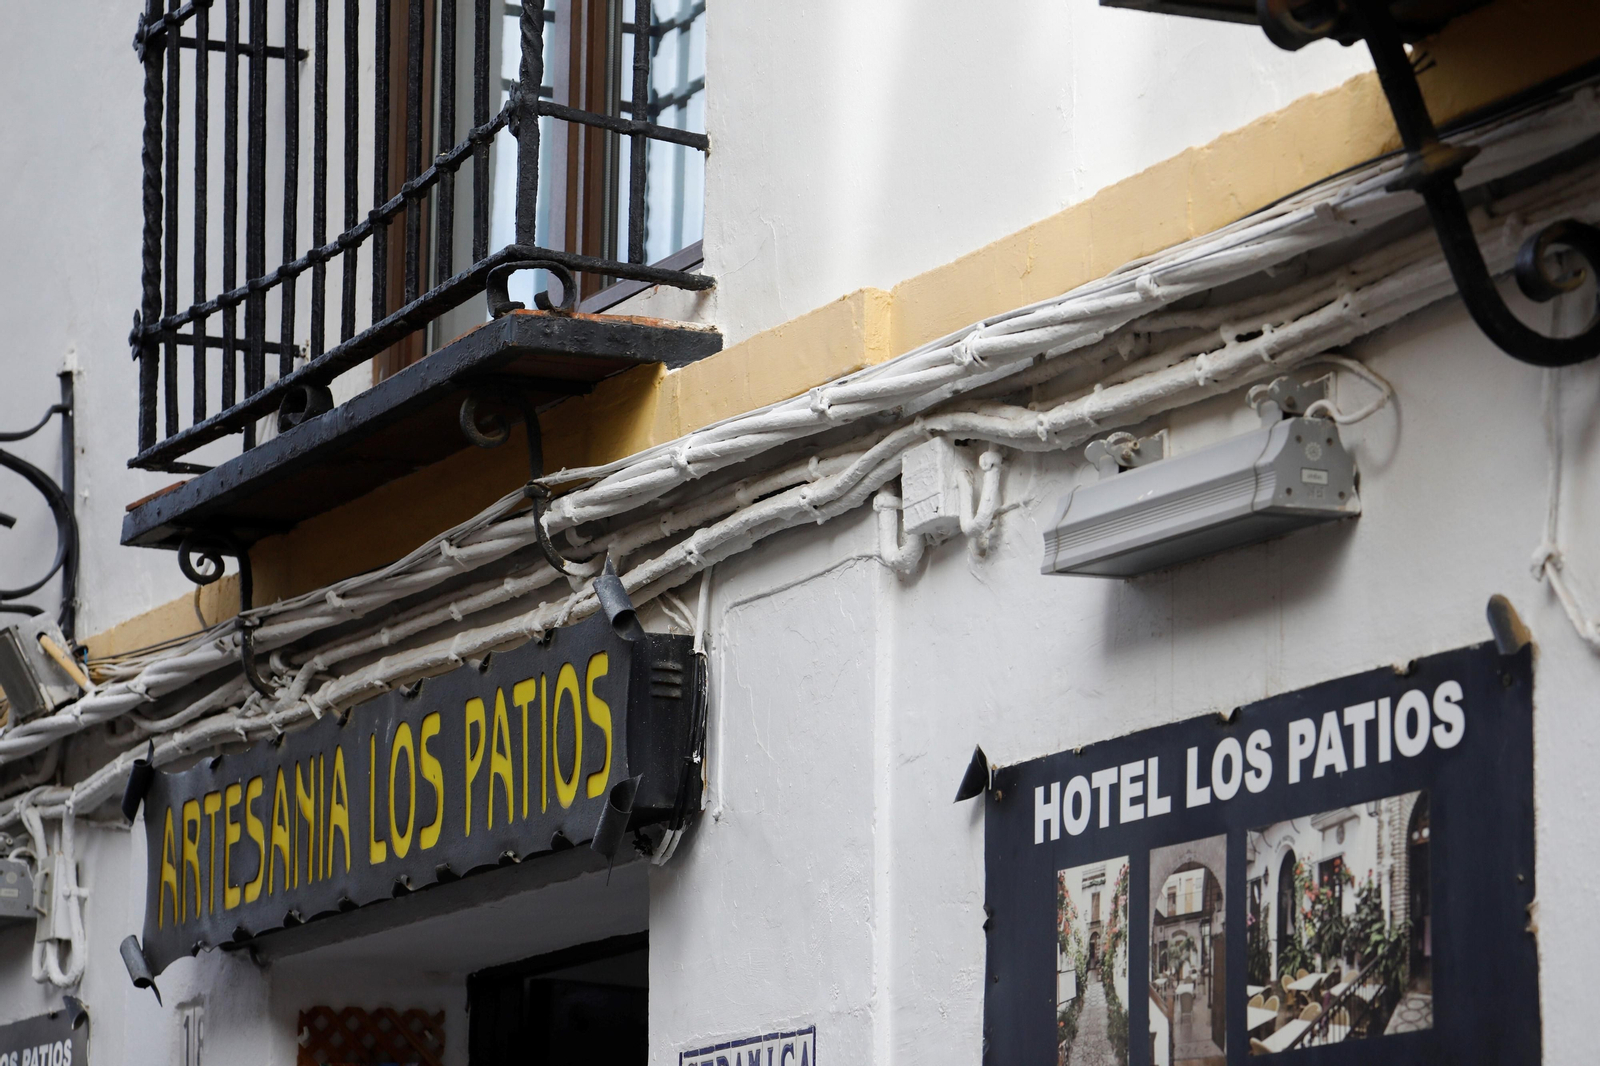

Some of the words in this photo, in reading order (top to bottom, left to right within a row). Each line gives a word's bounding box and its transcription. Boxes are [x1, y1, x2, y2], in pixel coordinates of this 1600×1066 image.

[159, 745, 351, 928] ARTESANIA
[369, 711, 445, 864] LOS
[464, 652, 613, 837] PATIOS
[1034, 756, 1172, 845] HOTEL
[1186, 728, 1273, 809] LOS
[1288, 680, 1465, 785] PATIOS
[22, 1038, 72, 1066] PATIOS
